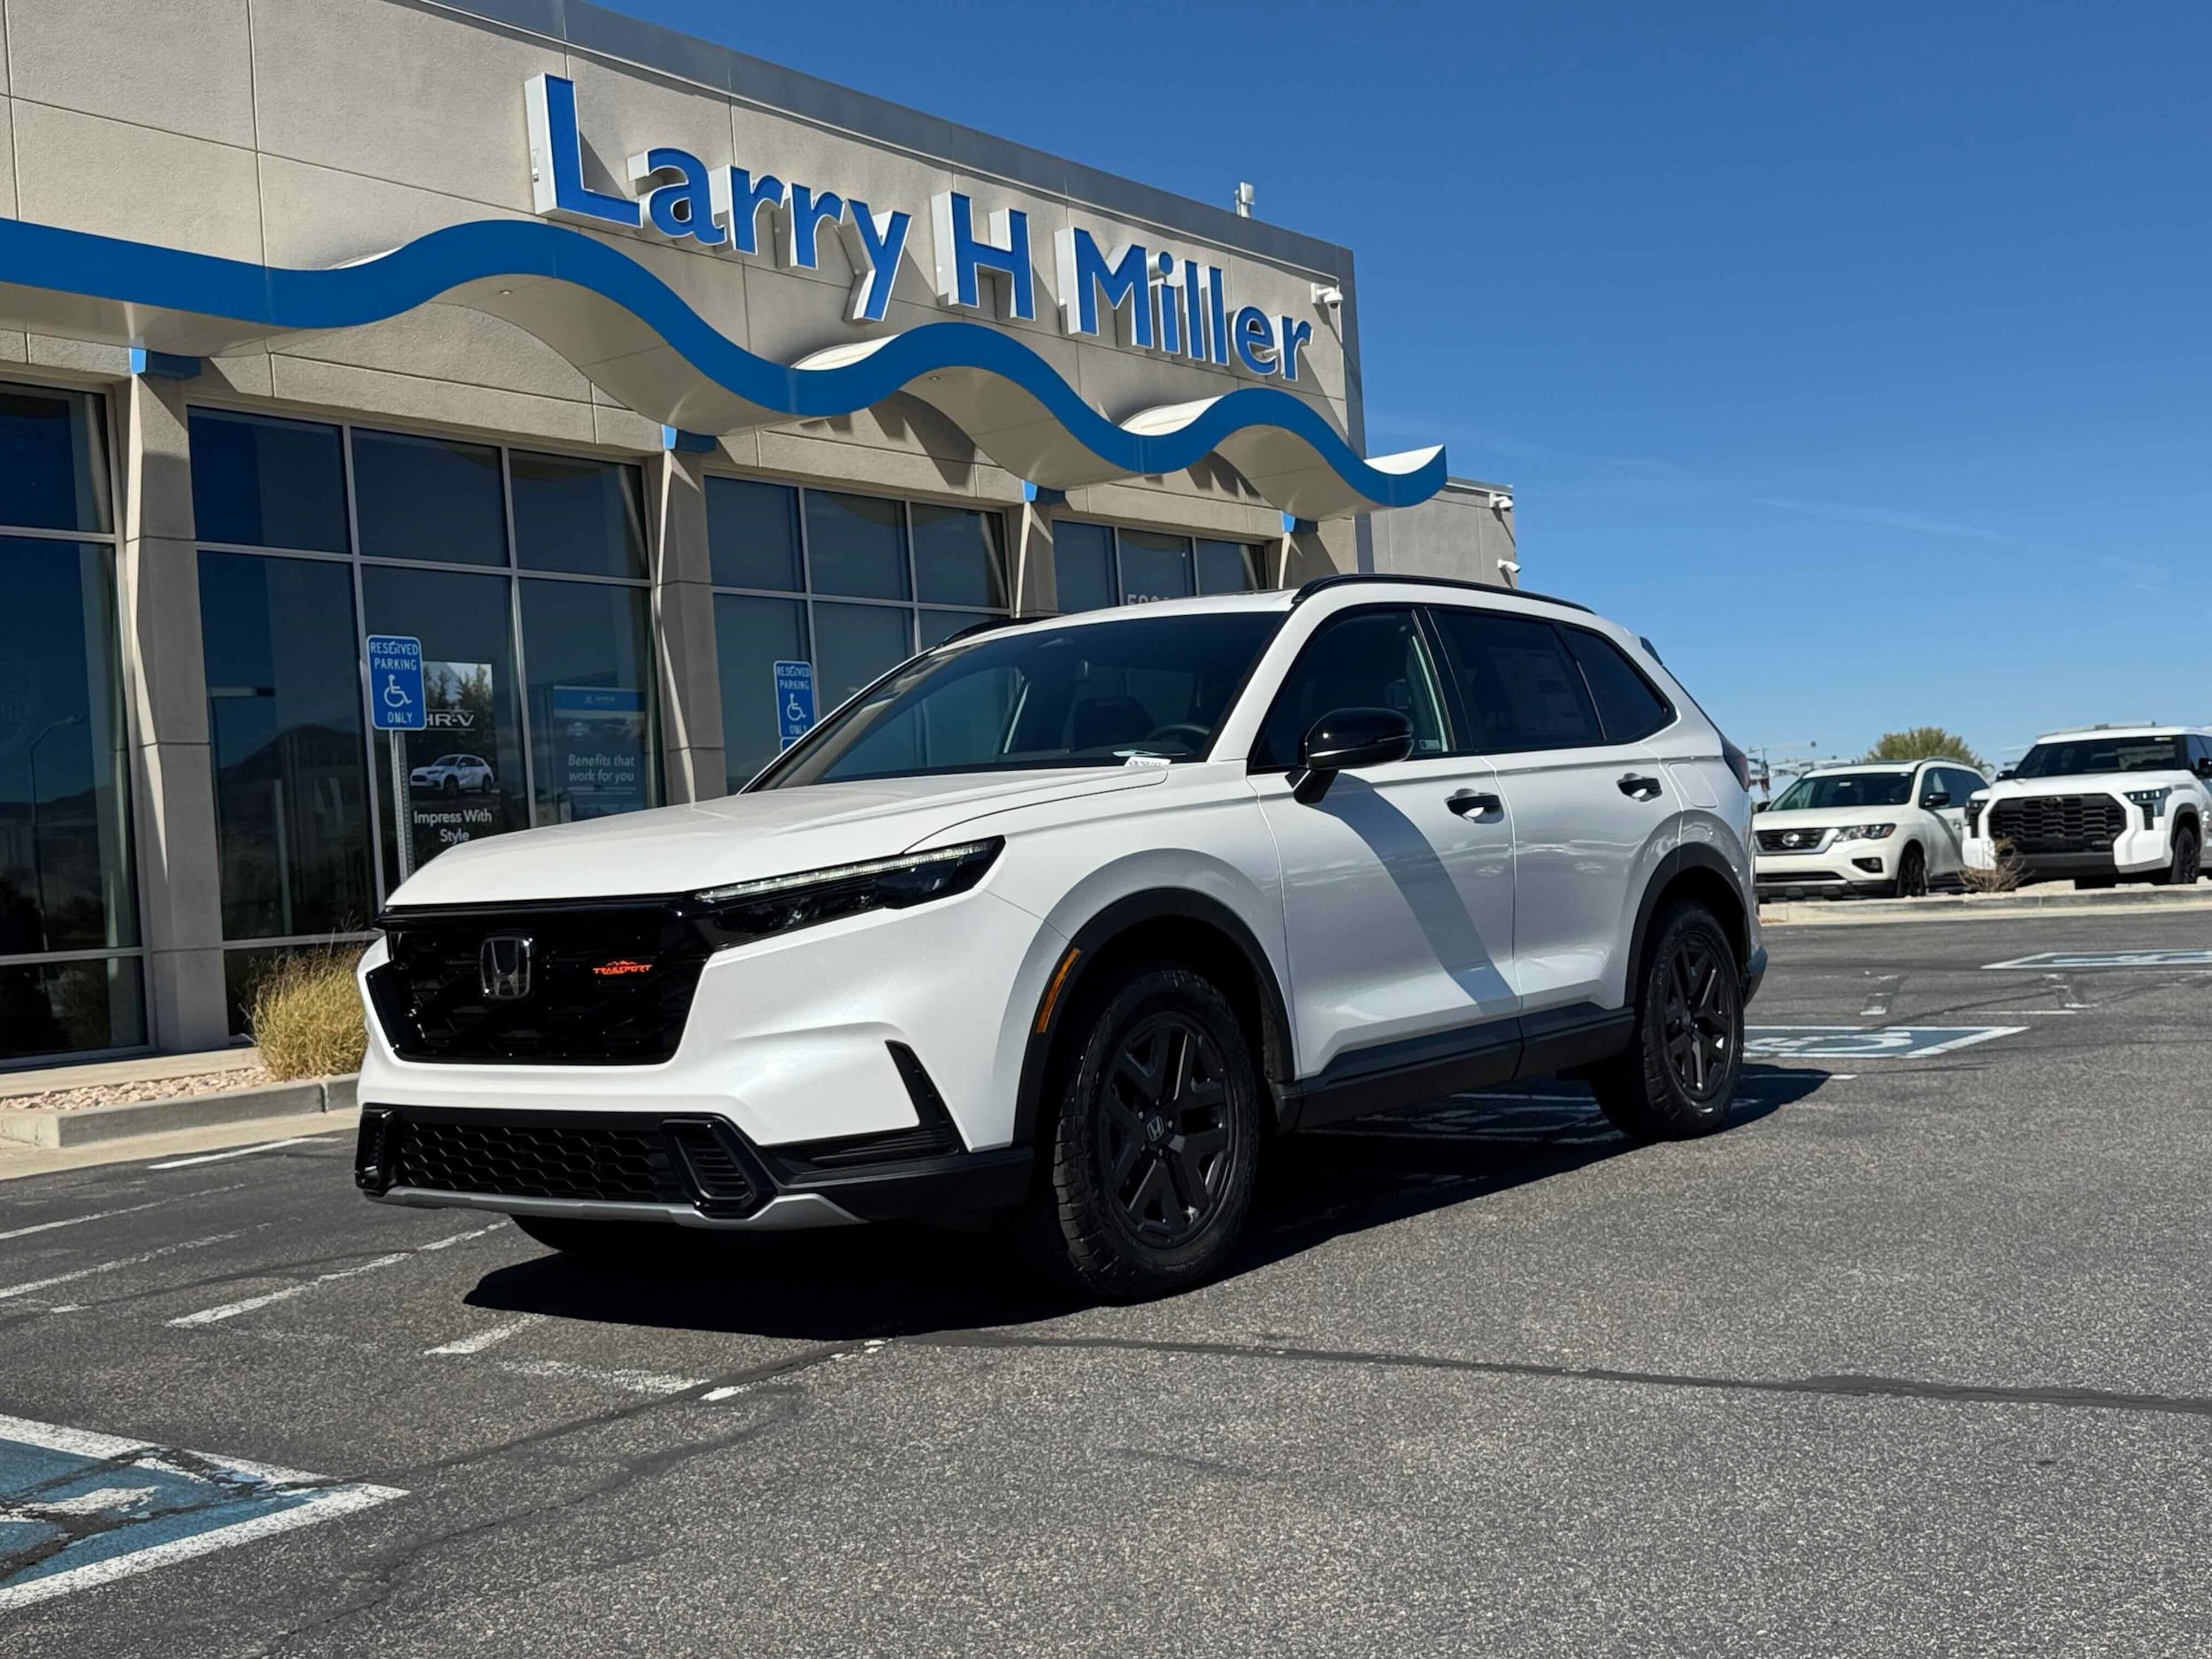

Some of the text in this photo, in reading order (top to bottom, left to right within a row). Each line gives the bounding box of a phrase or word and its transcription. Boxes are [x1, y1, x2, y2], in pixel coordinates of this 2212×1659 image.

[538, 73, 1314, 382] Larry H Miller
[370, 641, 419, 656] RESERVED
[374, 657, 418, 671] PARKING
[778, 666, 810, 677] RESERVED
[780, 680, 810, 690] PARKING
[387, 711, 413, 724] ONLY
[789, 725, 808, 734] ONLY
[567, 754, 635, 766] Benefits that
[568, 768, 635, 785] work for you
[413, 809, 493, 826] Impress With
[439, 828, 470, 844] Style
